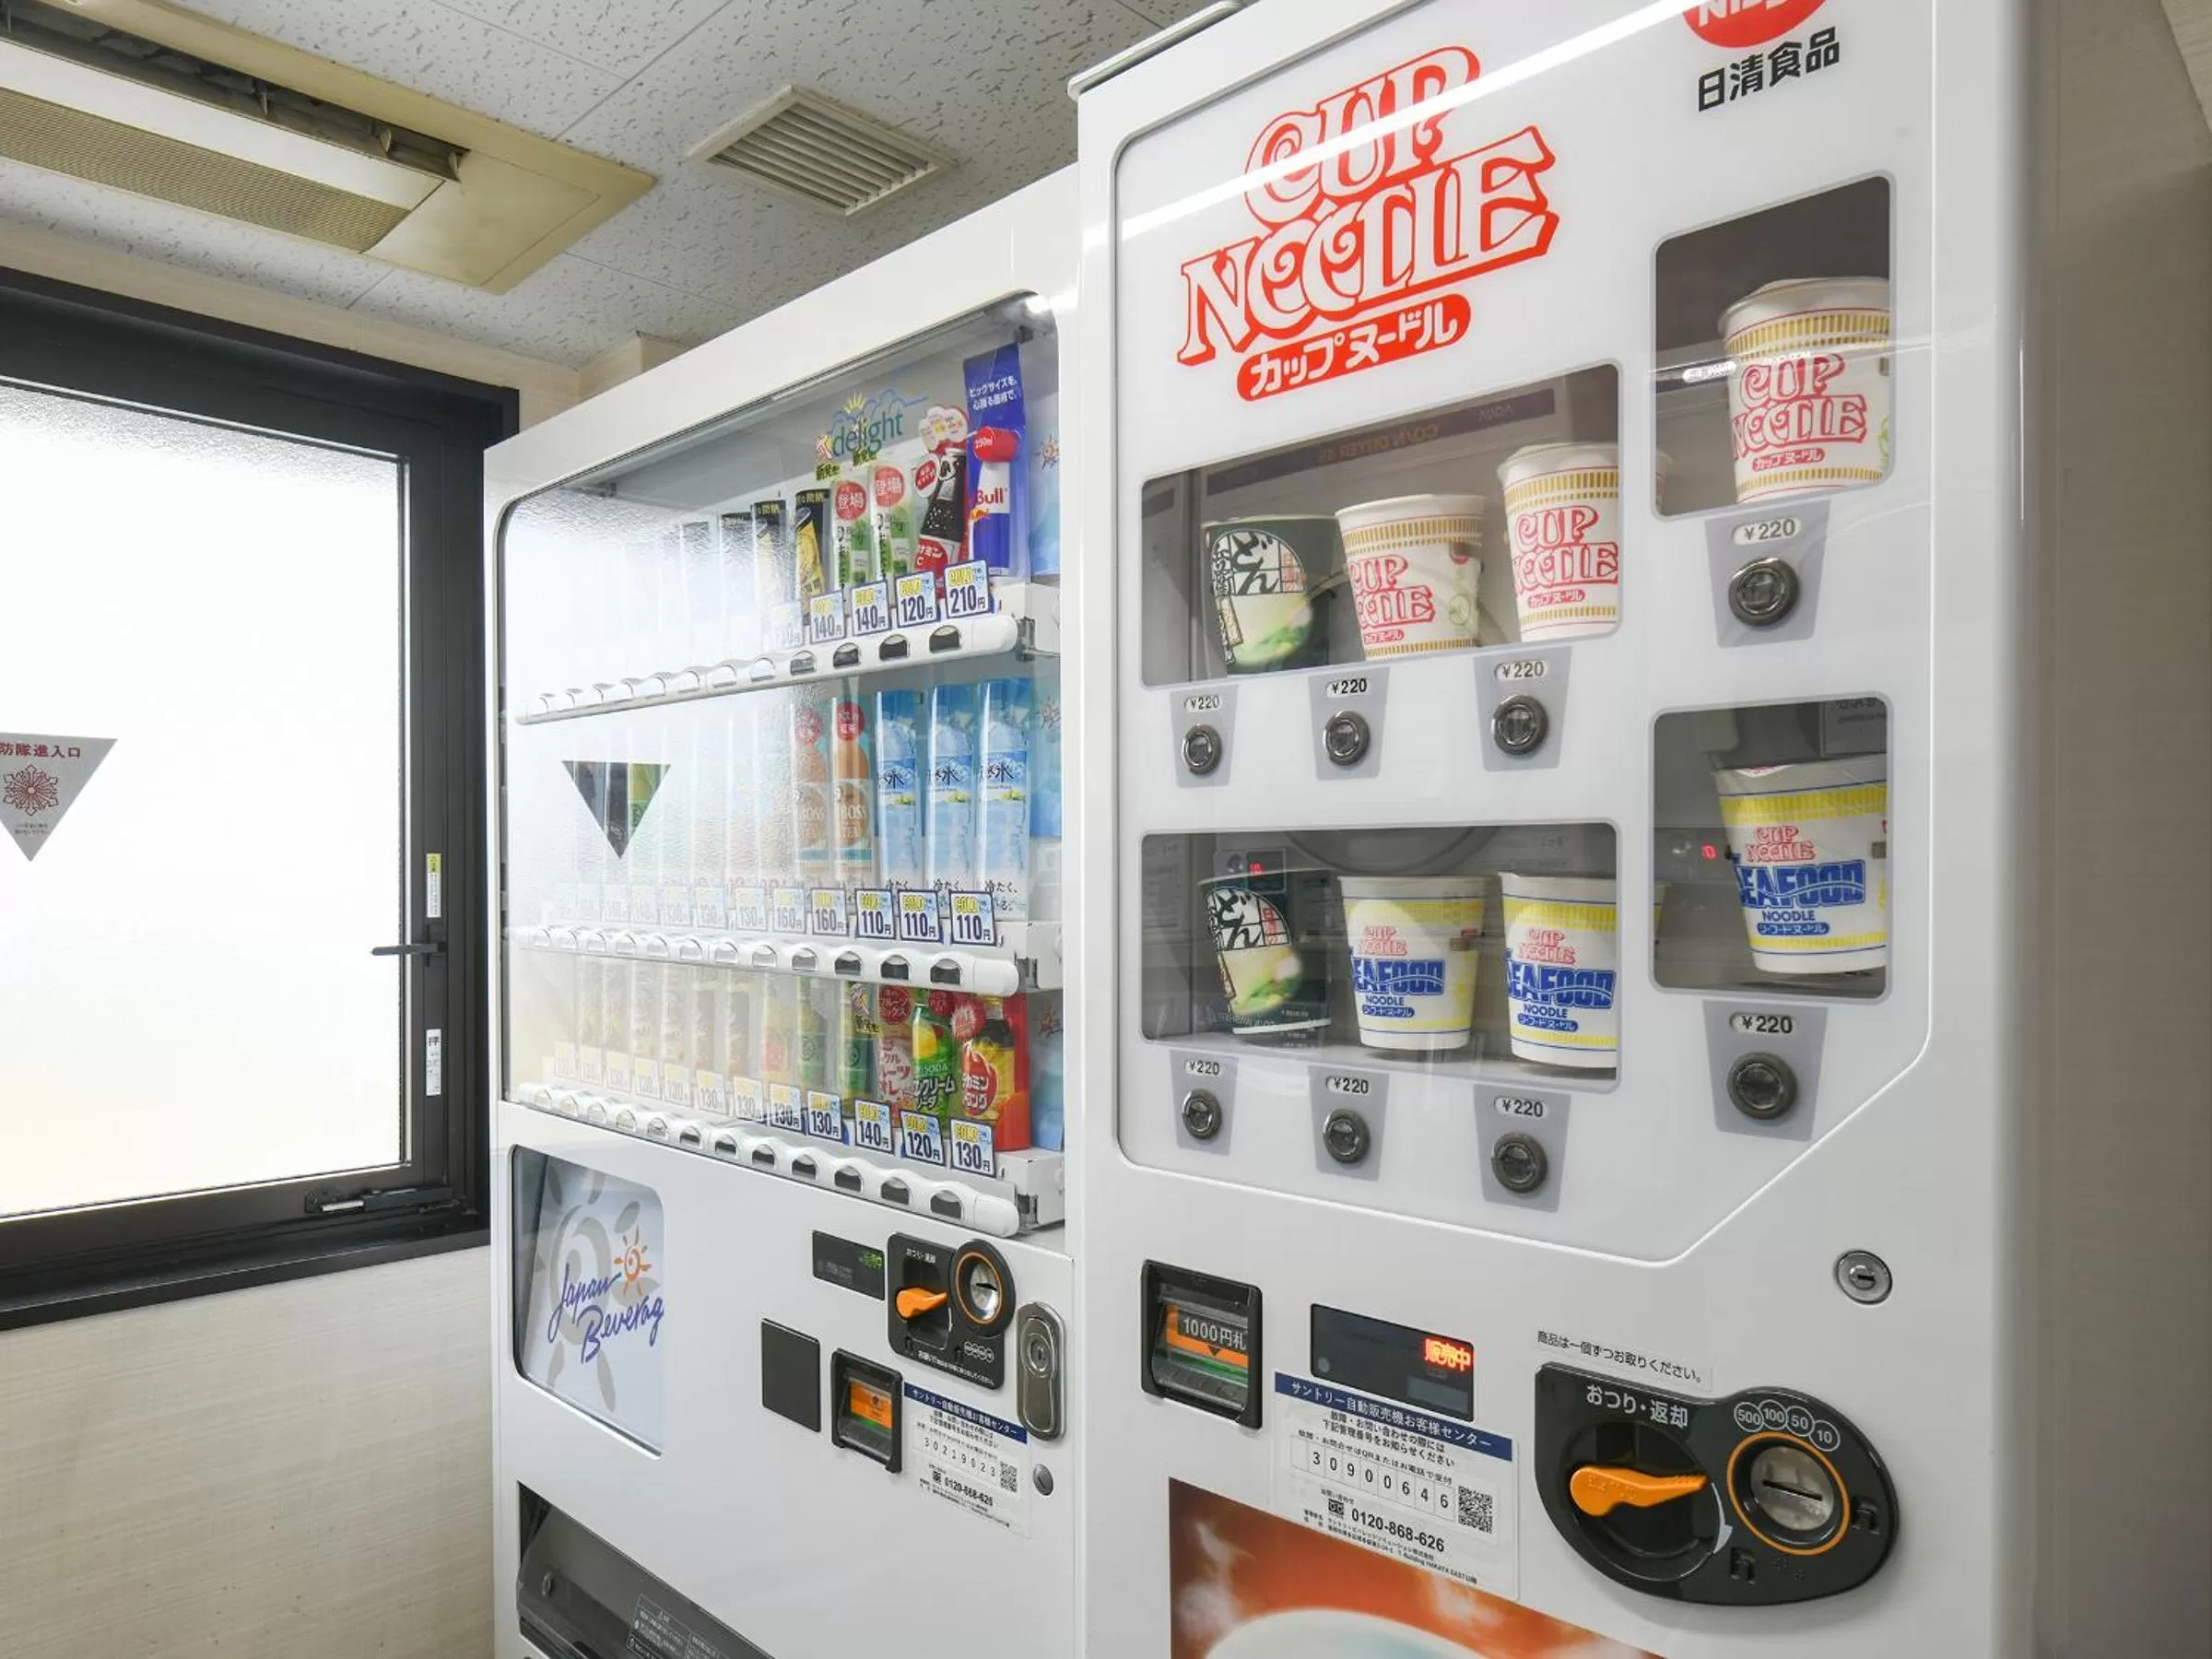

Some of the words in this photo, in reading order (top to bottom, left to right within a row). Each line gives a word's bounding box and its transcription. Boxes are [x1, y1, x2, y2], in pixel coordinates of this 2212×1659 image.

[1699, 27, 1840, 112] 日清食品
[1244, 45, 1482, 224] CUP
[1177, 125, 1559, 365] NOODLE
[1249, 305, 1459, 396] カップヌードル
[1741, 353, 1845, 408] CUP
[833, 407, 903, 457] delight
[975, 488, 1004, 504] Bull
[1516, 505, 1599, 552] CUP
[1744, 519, 1795, 541] ¥220
[901, 594, 933, 623] 120円
[950, 585, 986, 614] 210円
[1501, 661, 1545, 680] ¥220
[1332, 678, 1368, 696] ¥220
[1190, 695, 1221, 711] ¥220
[1733, 859, 1865, 910] EAFOOD
[862, 911, 892, 935] 110円
[904, 912, 936, 938] 110円
[957, 915, 992, 941] 110円
[1215, 888, 1263, 949] どん
[1761, 909, 1816, 923] NOODLE
[1351, 956, 1445, 995] EAFOOD
[1507, 960, 1617, 1009] EAFOOD
[1366, 995, 1405, 1006] NOODLE
[1524, 1003, 1568, 1018] NOODLE
[1741, 1015, 1794, 1034] ¥220
[1189, 1061, 1221, 1077] ¥220
[1334, 1077, 1369, 1095] ¥220
[811, 1110, 840, 1137] 130円
[1502, 1100, 1544, 1118] ¥220
[859, 1121, 888, 1148] 140円
[908, 1132, 940, 1160] 120円
[956, 1141, 991, 1172] 130円
[547, 1263, 622, 1343] Japan
[1183, 1317, 1247, 1350] 1000円札
[1425, 1337, 1472, 1372] 販売中
[1537, 1330, 1701, 1383] 商品は一個ずつお取りください。
[1290, 1381, 1492, 1448] サントリー自動販売機お客様センター
[1586, 1384, 1688, 1429] おつり・返却
[1737, 1409, 1761, 1426] 500
[1764, 1407, 1784, 1423] 100
[1791, 1415, 1809, 1430] 50
[1817, 1430, 1833, 1444] 10
[1351, 1508, 1445, 1553] 0120-868-626
